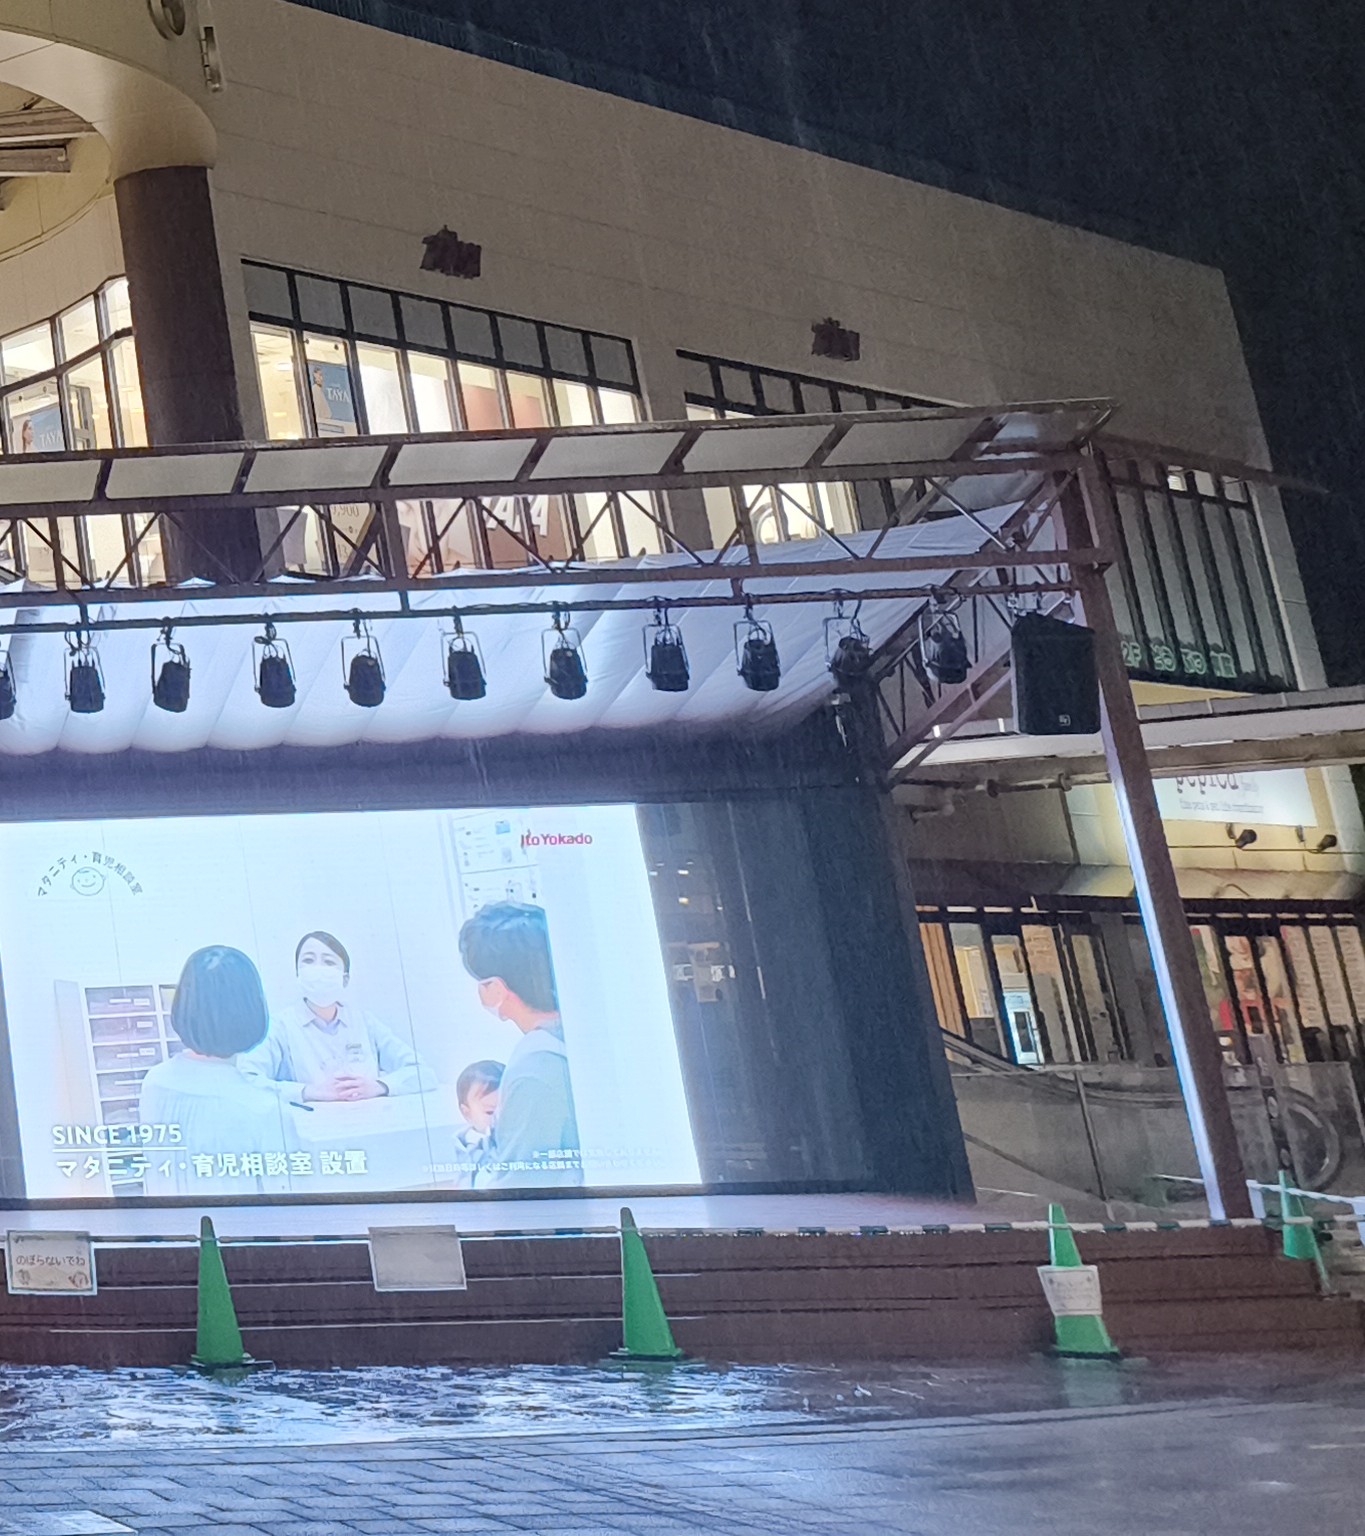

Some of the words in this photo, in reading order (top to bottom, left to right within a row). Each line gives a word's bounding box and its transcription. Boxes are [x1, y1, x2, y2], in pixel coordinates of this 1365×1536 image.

[52, 1125, 122, 1146] SINCE
[128, 1123, 183, 1144] 1975
[56, 1151, 314, 1179] マタニティ・育児相談室
[318, 1150, 369, 1175] 設置
